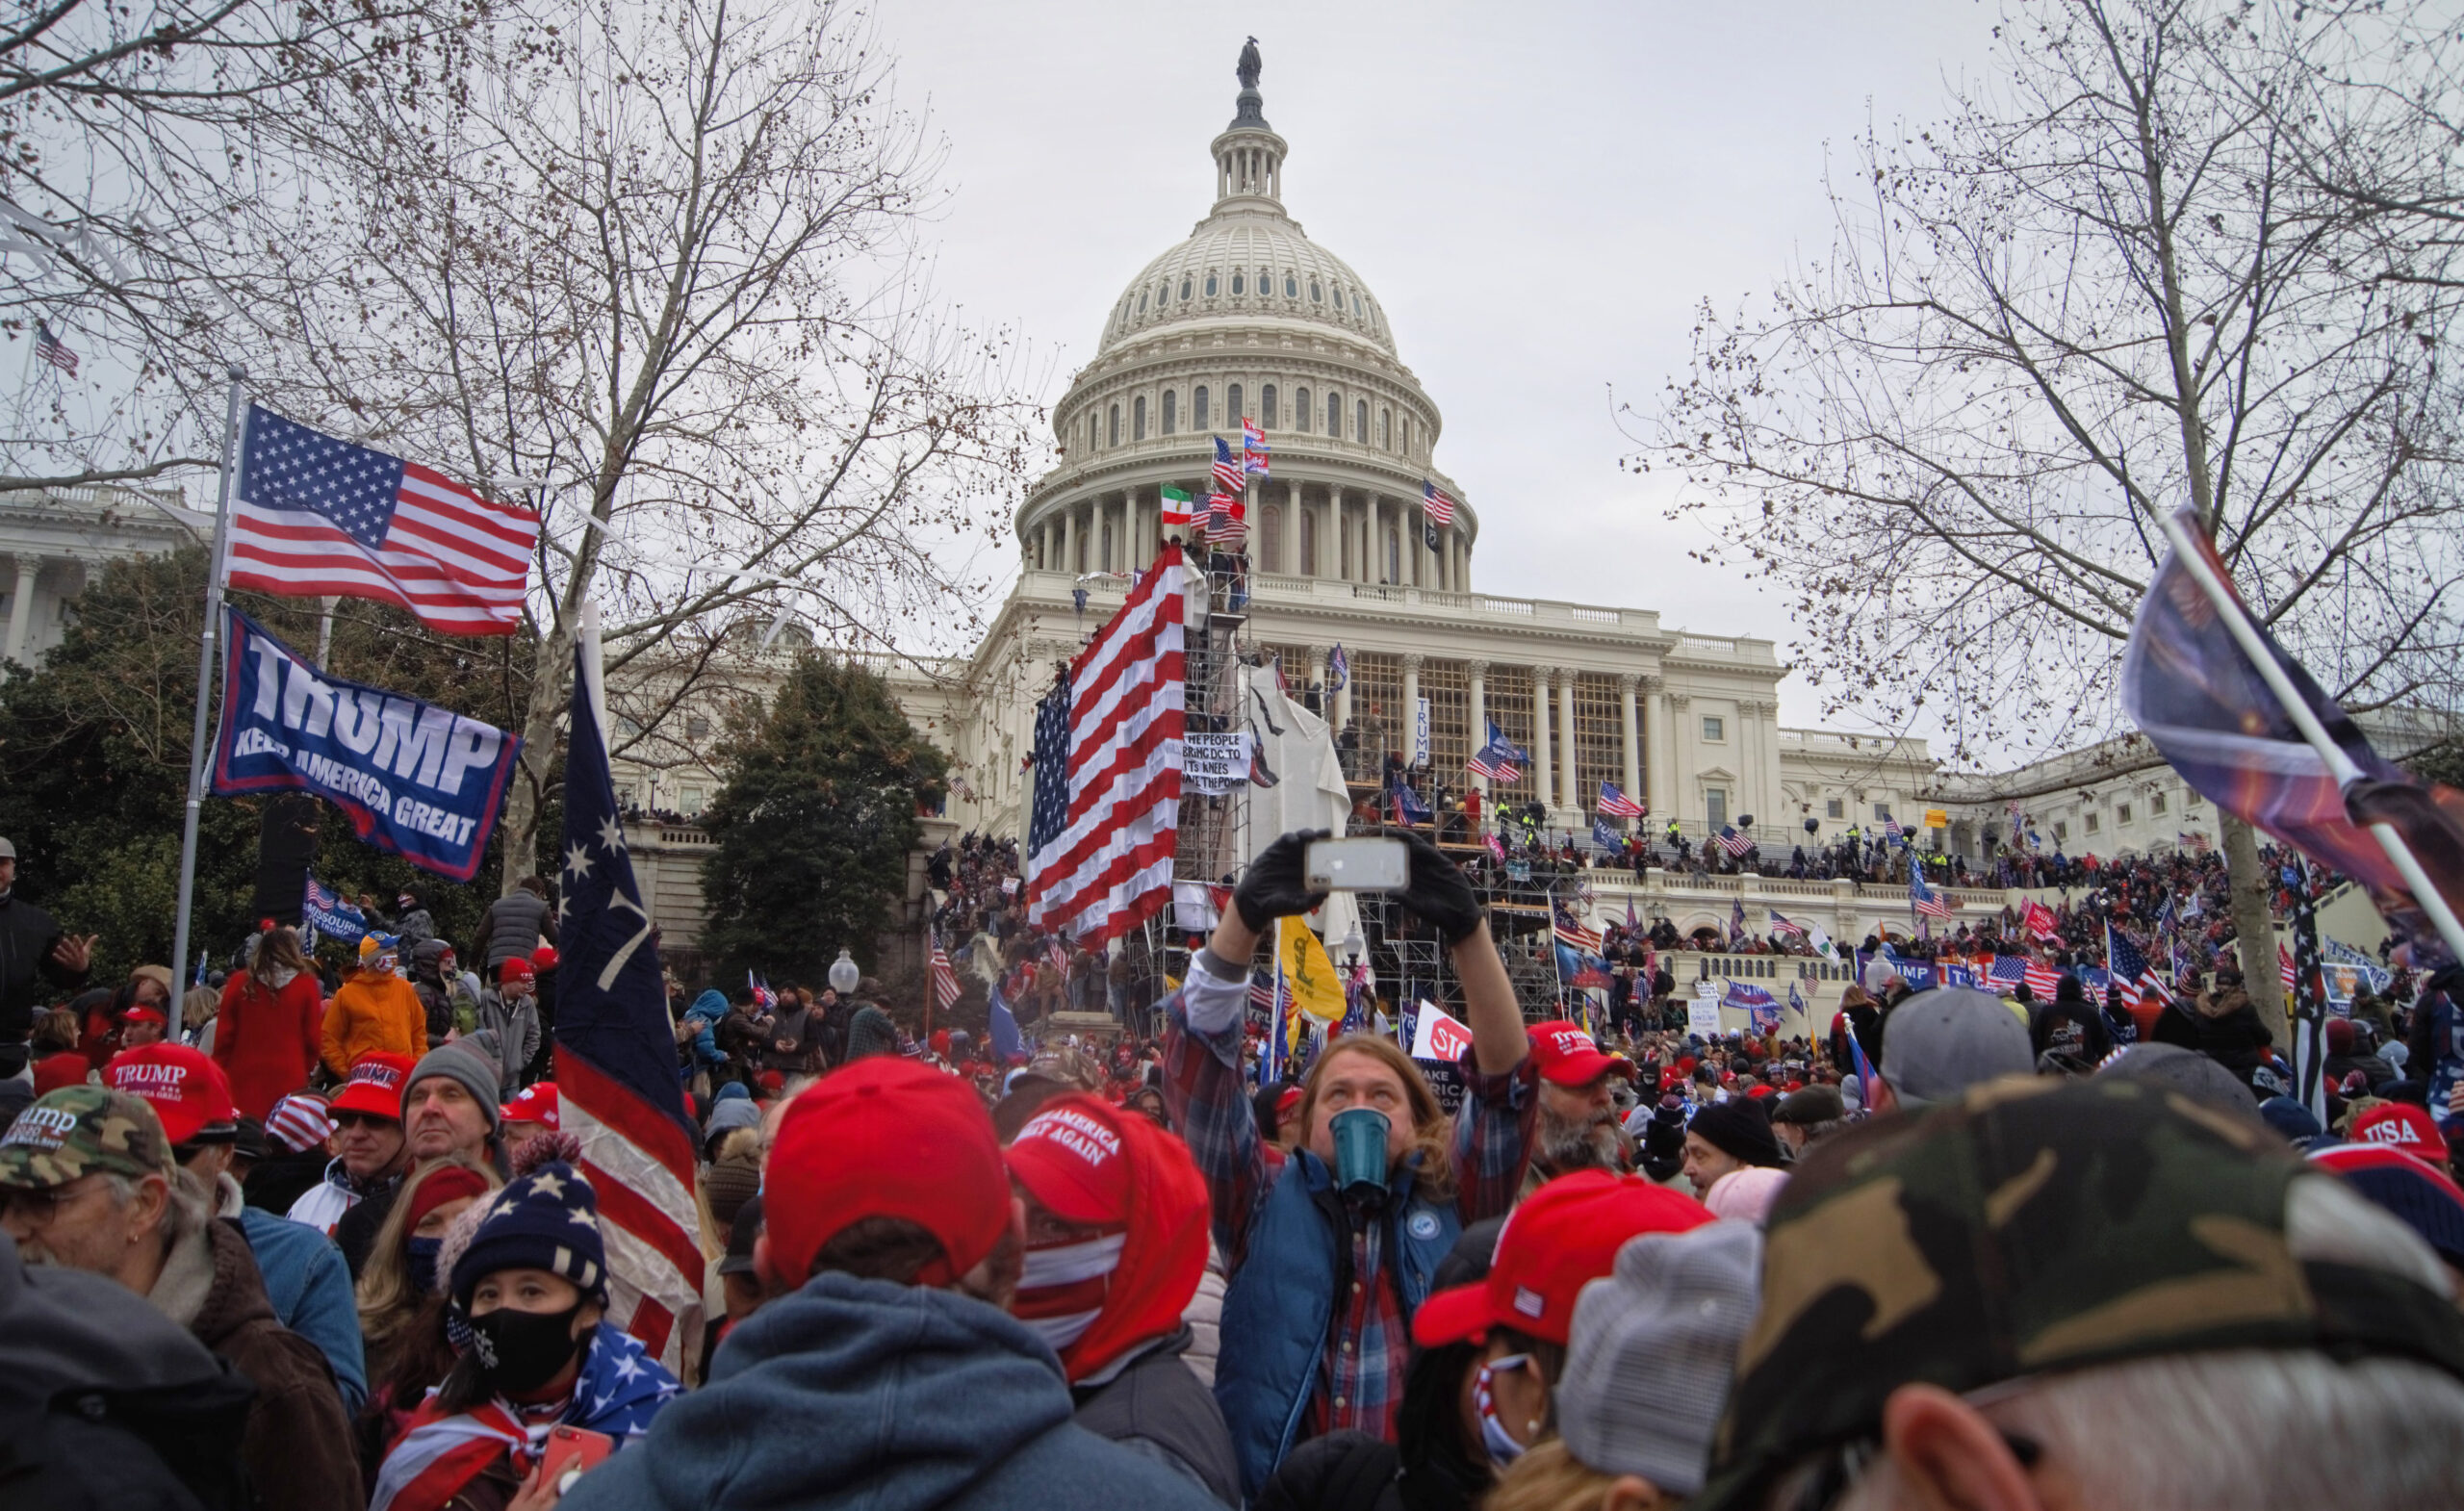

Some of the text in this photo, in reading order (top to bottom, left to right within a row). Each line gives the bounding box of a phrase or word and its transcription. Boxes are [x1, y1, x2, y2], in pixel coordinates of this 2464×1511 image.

[249, 633, 501, 796] TRUMP
[1188, 733, 1240, 746] HE PEOPLE
[1417, 700, 1428, 764] TRUMP
[1210, 748, 1225, 760] DC
[1225, 749, 1241, 760] TO
[295, 749, 392, 816] AMERICA
[394, 796, 477, 847] GREAT
[306, 903, 356, 933] MISSOURI
[597, 886, 651, 992] 7
[1432, 1026, 1469, 1061] STO
[116, 1063, 187, 1086] TRUMP
[1424, 1070, 1450, 1082] AKE
[1429, 1084, 1473, 1098] RICA
[19, 1106, 77, 1137] ump
[2363, 1118, 2422, 1144] USA
[1047, 1124, 1108, 1167] AGAIN
